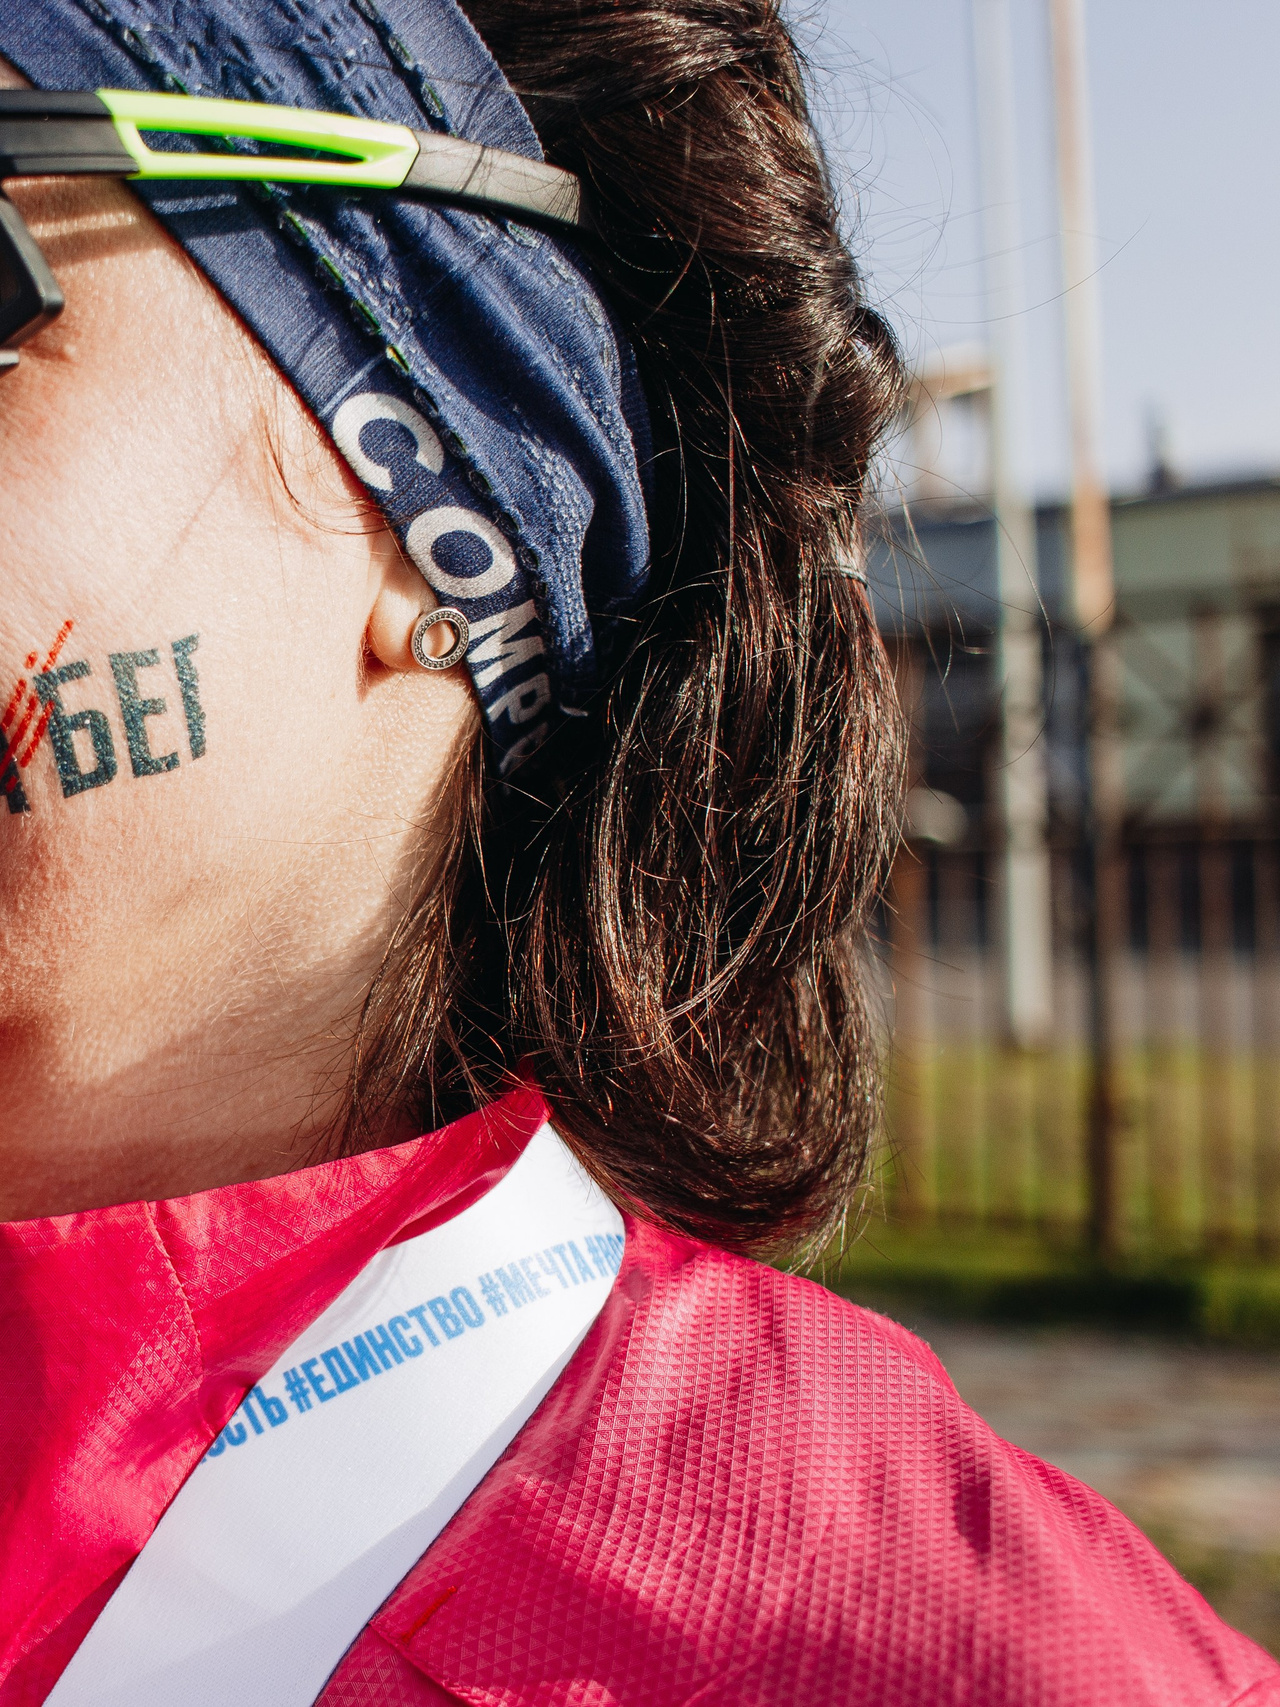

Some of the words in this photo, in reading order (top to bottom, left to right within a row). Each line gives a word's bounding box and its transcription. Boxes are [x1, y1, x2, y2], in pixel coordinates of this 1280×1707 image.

[200, 1385, 289, 1464] СТЬ
[282, 1285, 486, 1414] #ЕДИНСТВО
[477, 1240, 587, 1318] #МЕЧТА
